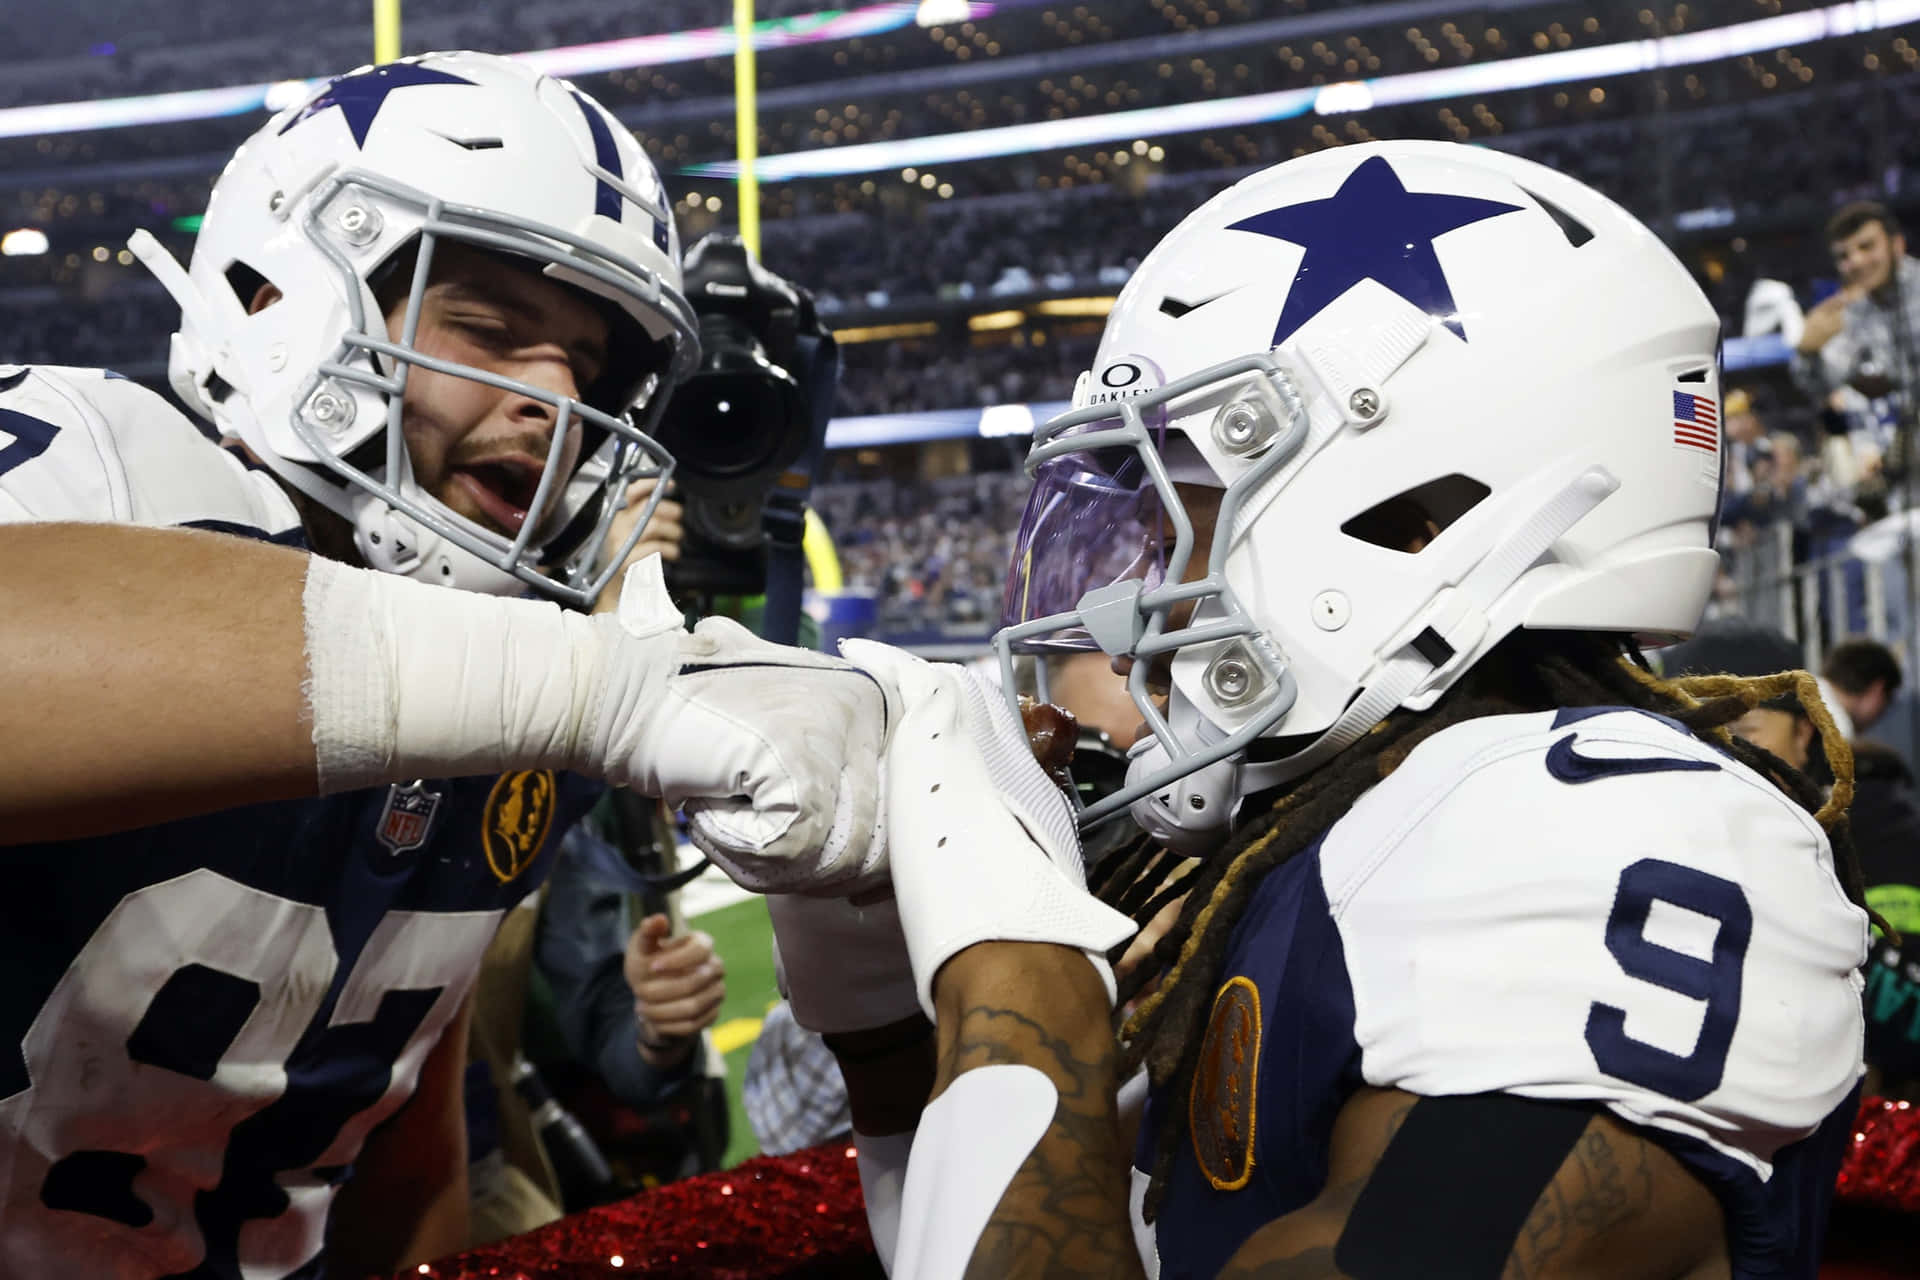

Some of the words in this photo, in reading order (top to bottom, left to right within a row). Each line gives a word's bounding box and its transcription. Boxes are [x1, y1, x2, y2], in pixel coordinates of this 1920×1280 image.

[1090, 388, 1153, 405] OAKLE
[385, 810, 426, 846] NFL
[1584, 857, 1753, 1103] 9
[0, 867, 506, 1280] 87
